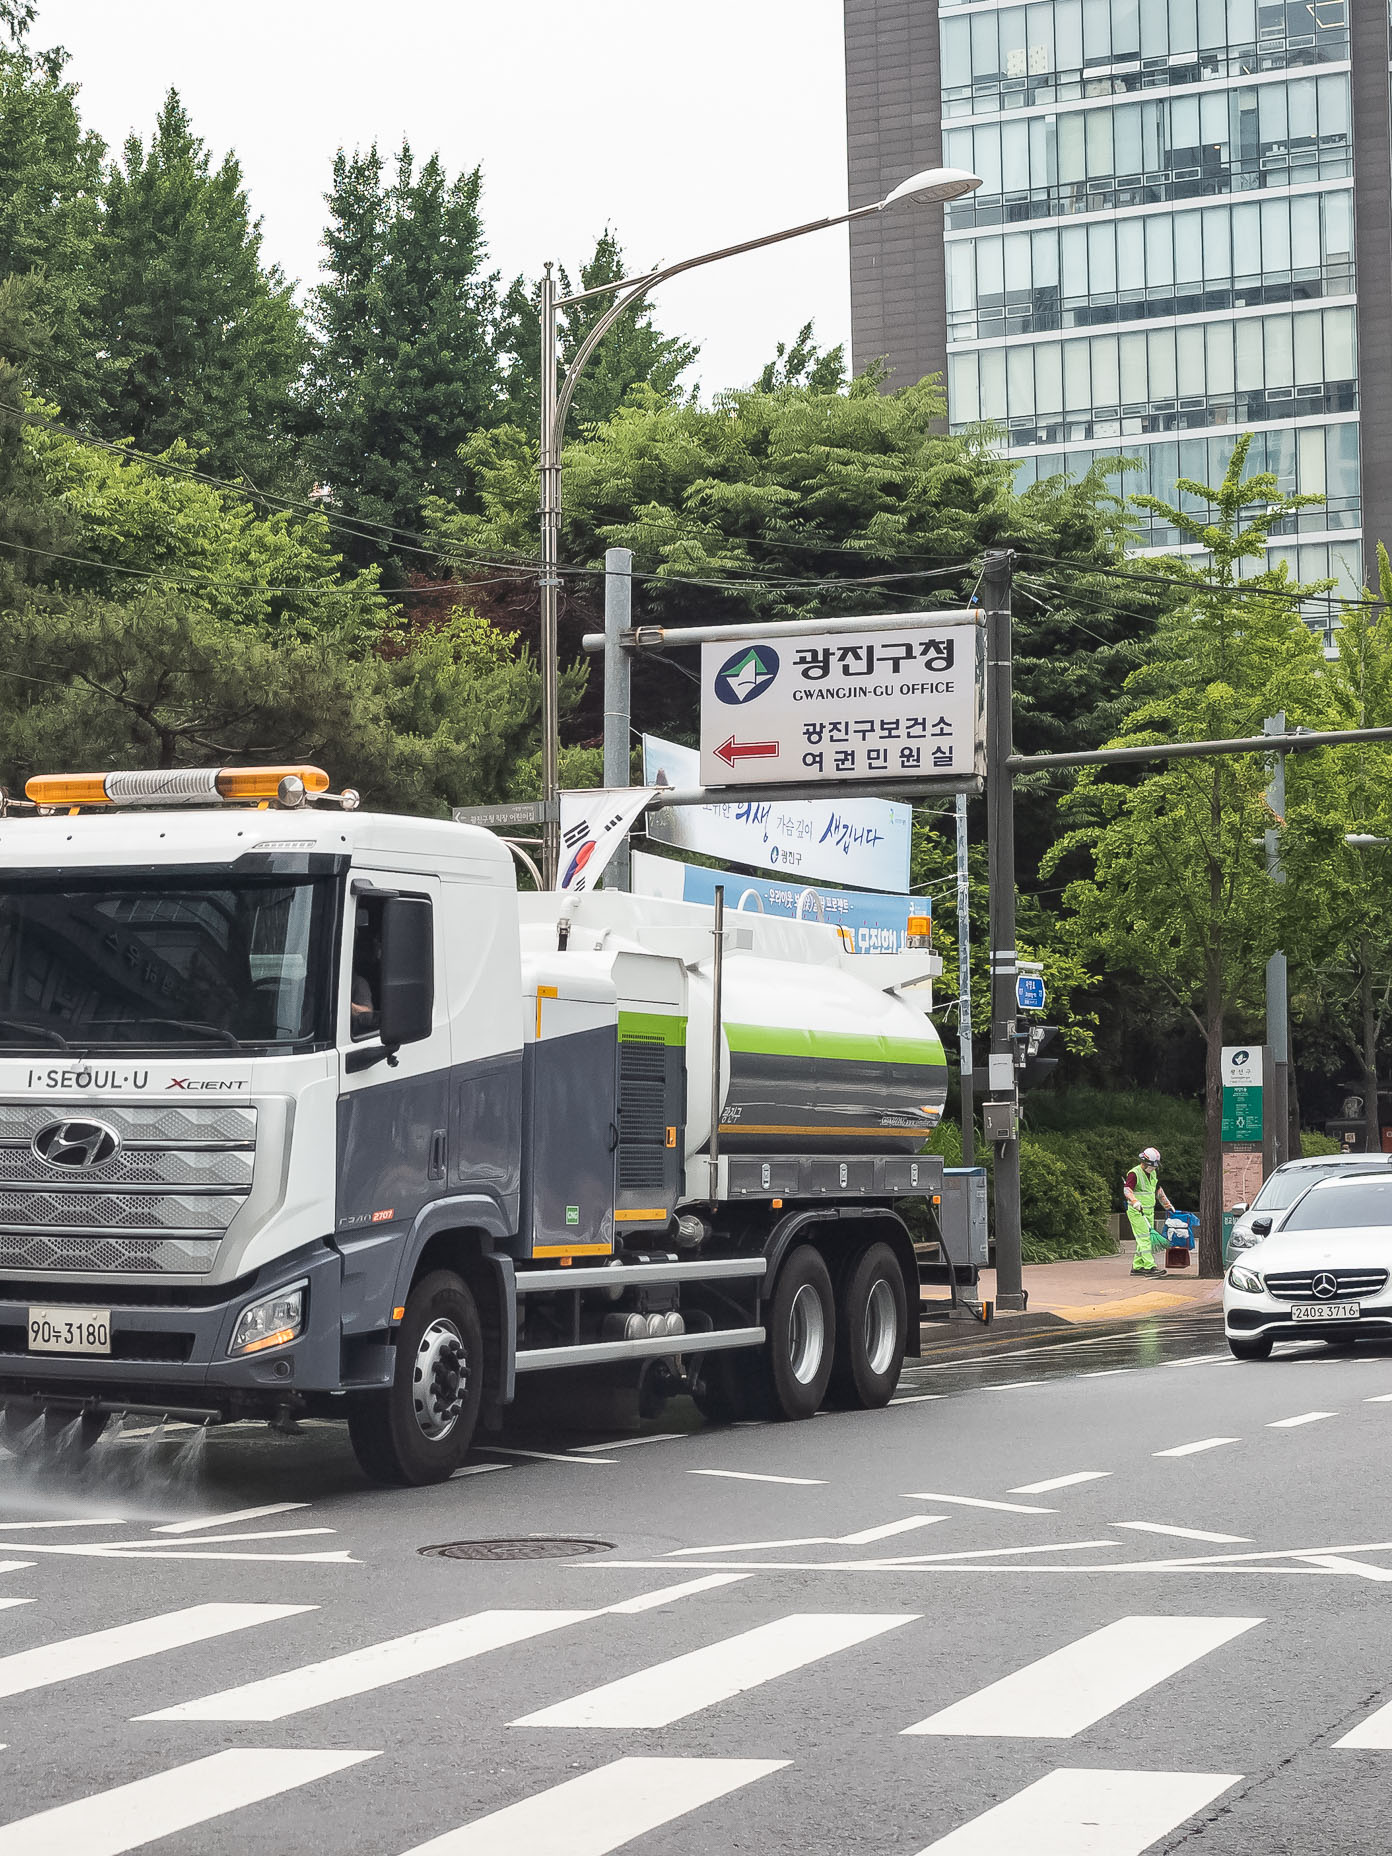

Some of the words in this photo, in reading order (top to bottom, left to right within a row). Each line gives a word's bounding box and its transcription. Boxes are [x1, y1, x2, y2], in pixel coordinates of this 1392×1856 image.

[792, 638, 955, 681] 광진구청
[792, 684, 894, 702] GWANGJIN-GU
[899, 681, 955, 696] OFFICE
[802, 715, 953, 745] 광진구보건소
[818, 812, 885, 855] 새깁니다
[781, 849, 803, 866] 광진구
[825, 896, 849, 915] 프로젝트
[721, 1106, 743, 1124] 광진구
[30, 1320, 108, 1346] 90누3180
